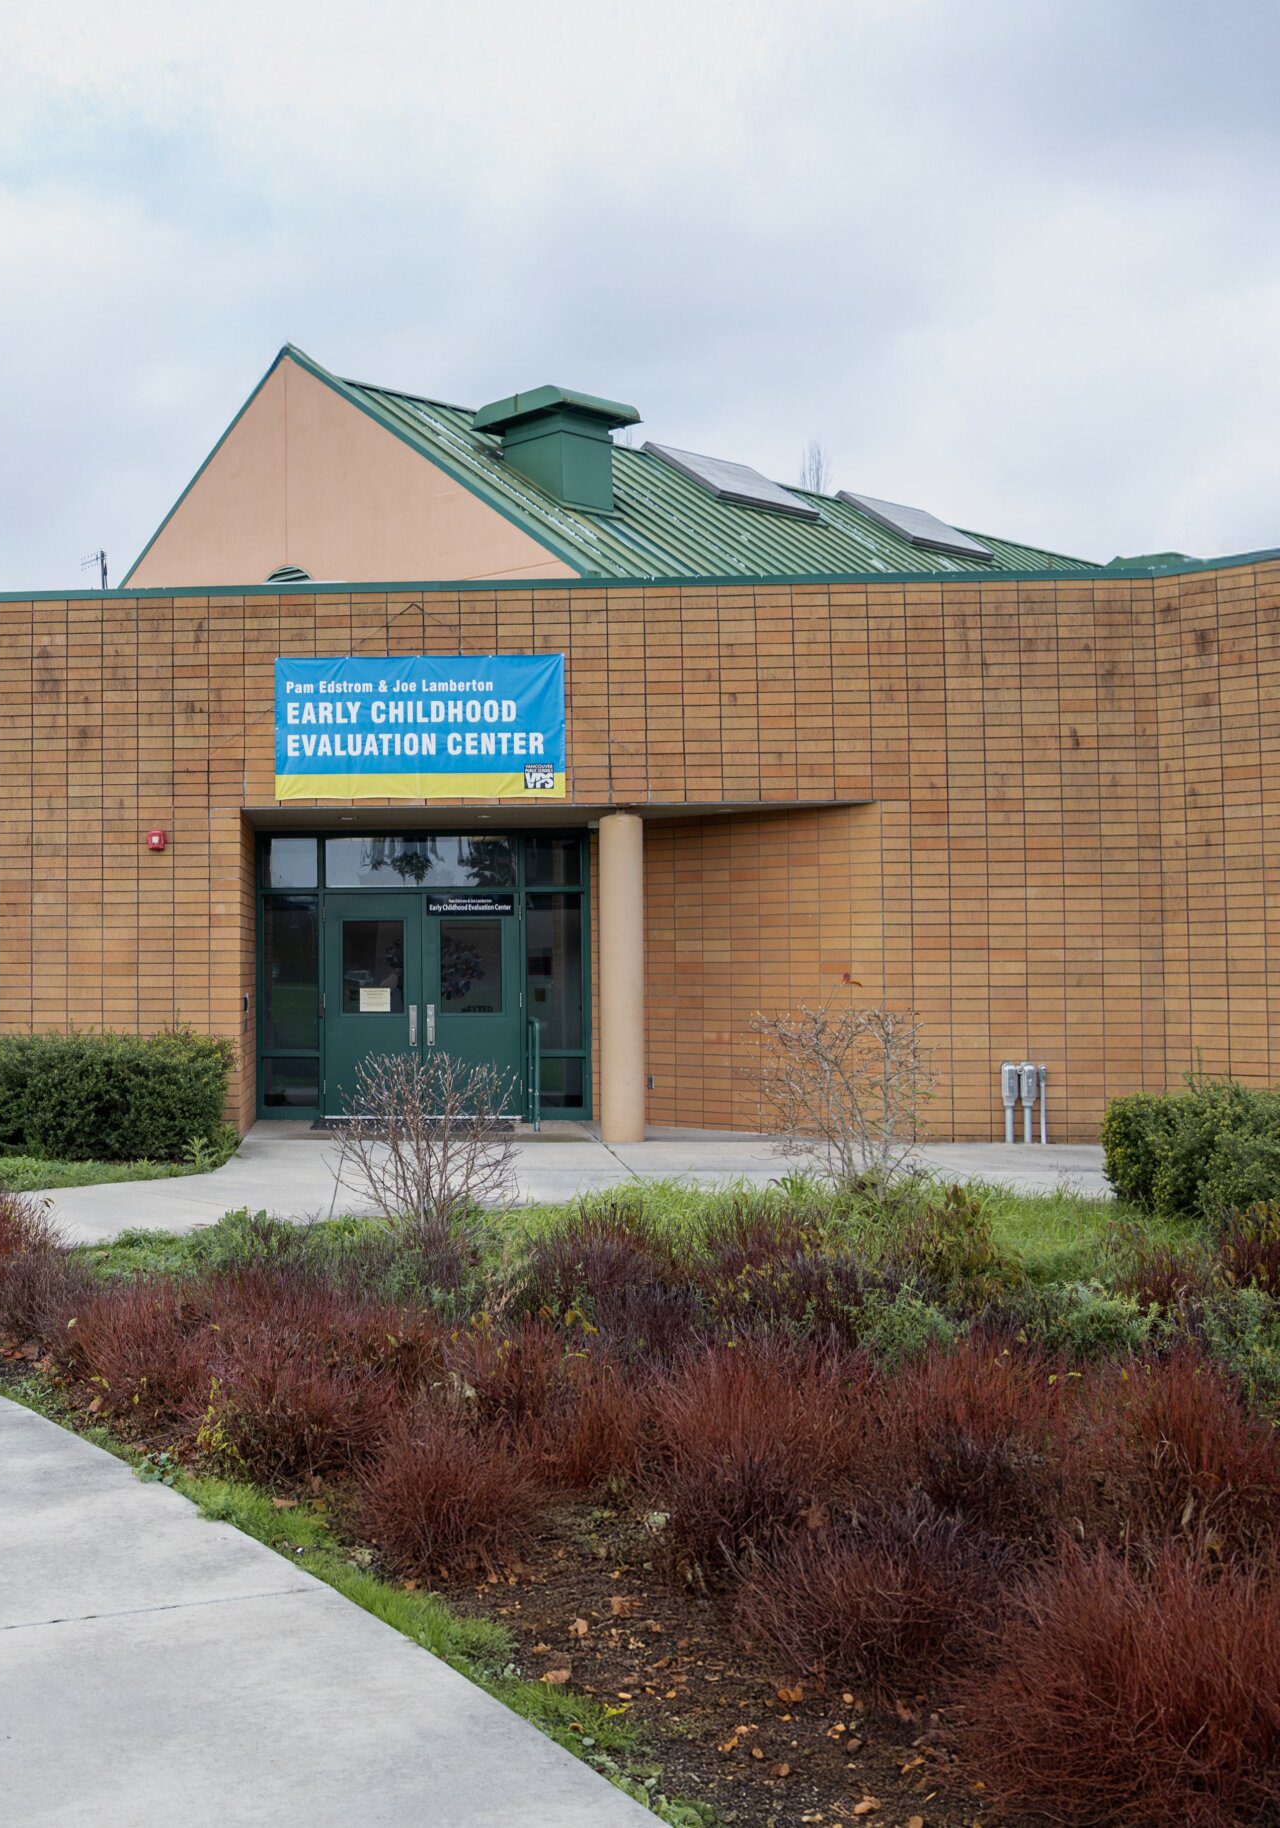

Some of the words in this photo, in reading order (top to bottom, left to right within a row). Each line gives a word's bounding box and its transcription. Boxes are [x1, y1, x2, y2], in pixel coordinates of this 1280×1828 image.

[286, 681, 314, 694] Pam
[319, 680, 373, 693] Edstrom
[378, 680, 388, 693] &
[393, 680, 417, 693] Joe
[422, 679, 493, 692] Lamberton
[286, 701, 361, 725] EARLY
[371, 700, 517, 724] CHILDHOOD
[287, 732, 436, 757] EVALUATION
[447, 732, 545, 756] CENTER
[525, 772, 553, 788] VPS
[429, 904, 442, 912] Early
